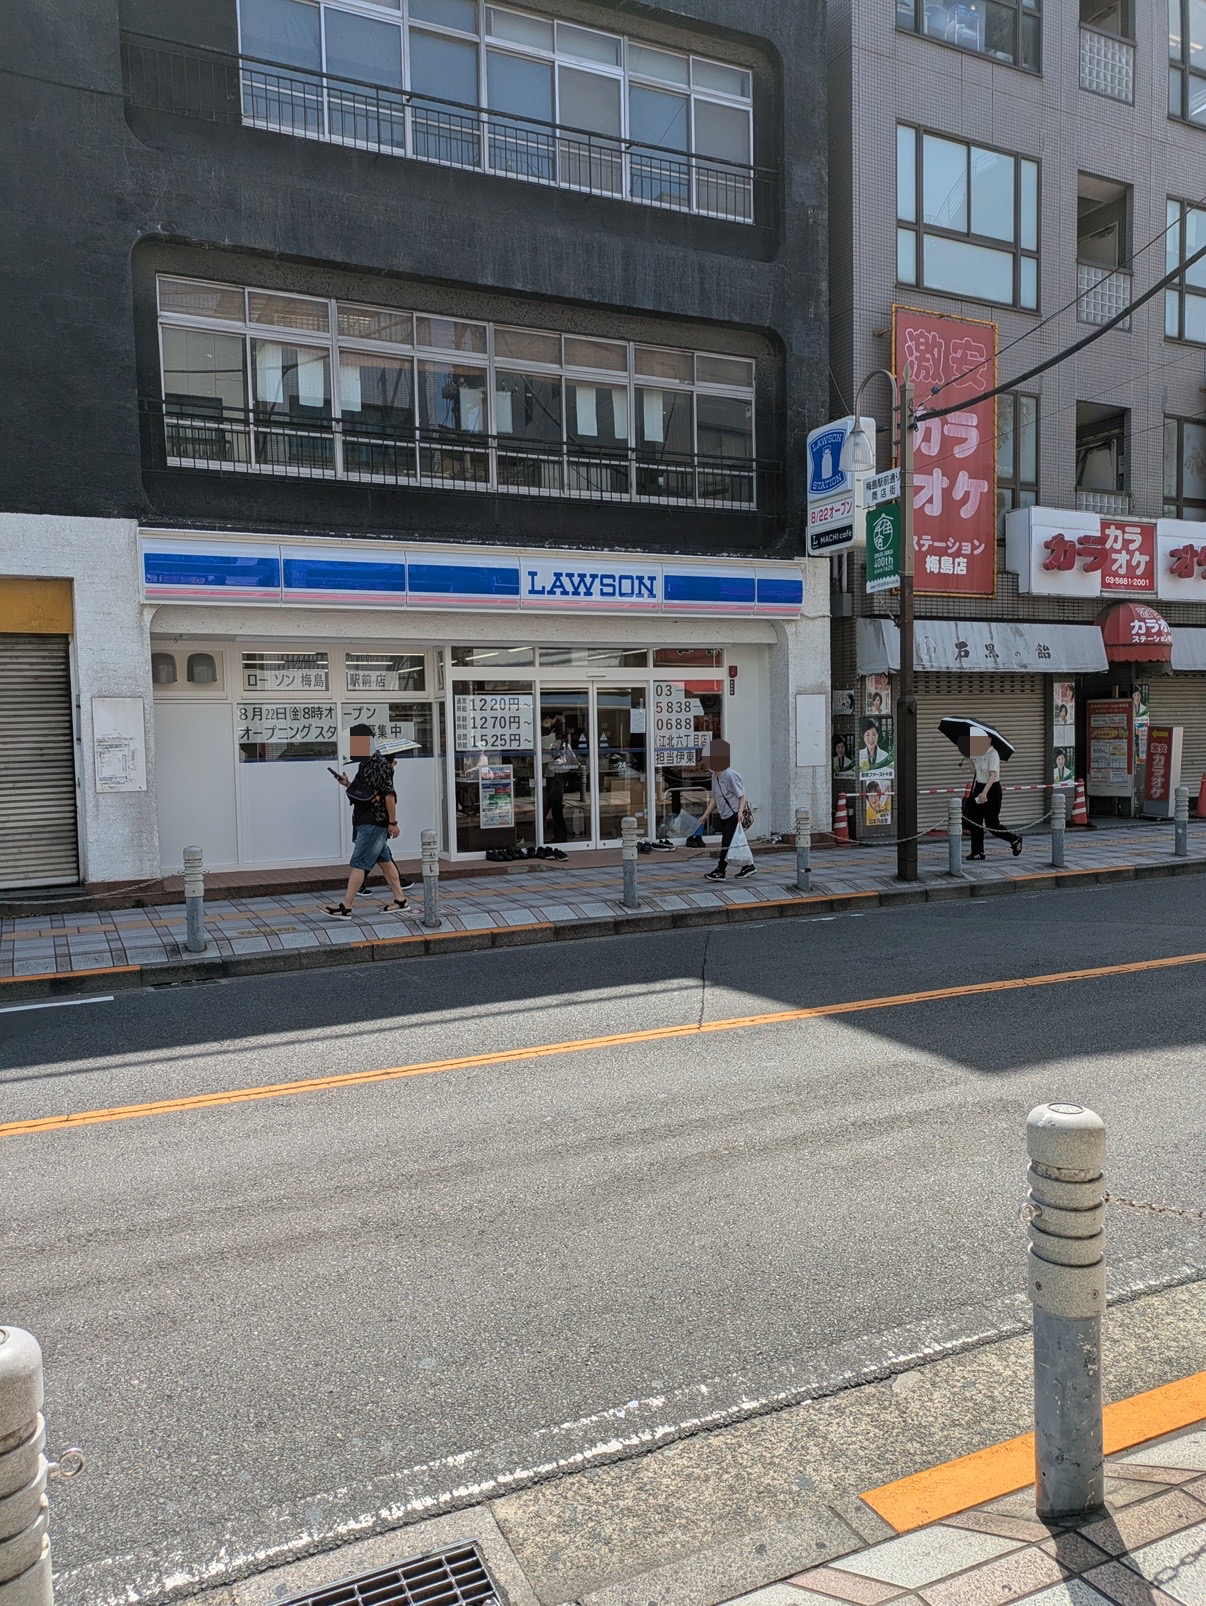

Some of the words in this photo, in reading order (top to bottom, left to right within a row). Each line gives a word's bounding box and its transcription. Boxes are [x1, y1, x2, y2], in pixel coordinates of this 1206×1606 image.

[905, 328, 987, 390] 激安
[913, 405, 980, 458] カラ
[812, 433, 842, 452] LAWSON
[812, 472, 842, 490] STATION
[866, 470, 900, 492] 梅島駅前通り
[871, 486, 896, 501] 商店街
[913, 467, 989, 519] オケ
[811, 501, 852, 524] 8/22オープン
[820, 534, 839, 544] MACHI
[1104, 524, 1142, 550] カラ
[874, 555, 894, 568] 400th
[1043, 533, 1108, 573] カラ
[1111, 550, 1150, 576] オケ
[925, 554, 968, 575] 梅島店
[528, 571, 657, 598] LAWSON
[1105, 576, 1149, 586] 03-5681-2001
[955, 640, 1051, 661] 石黒の飴
[248, 673, 324, 688] ローソン梅島
[350, 674, 386, 688] 駅前店
[240, 724, 336, 741] オープニングスタ
[657, 718, 692, 730] 0688
[656, 751, 696, 765] 担当伊東
